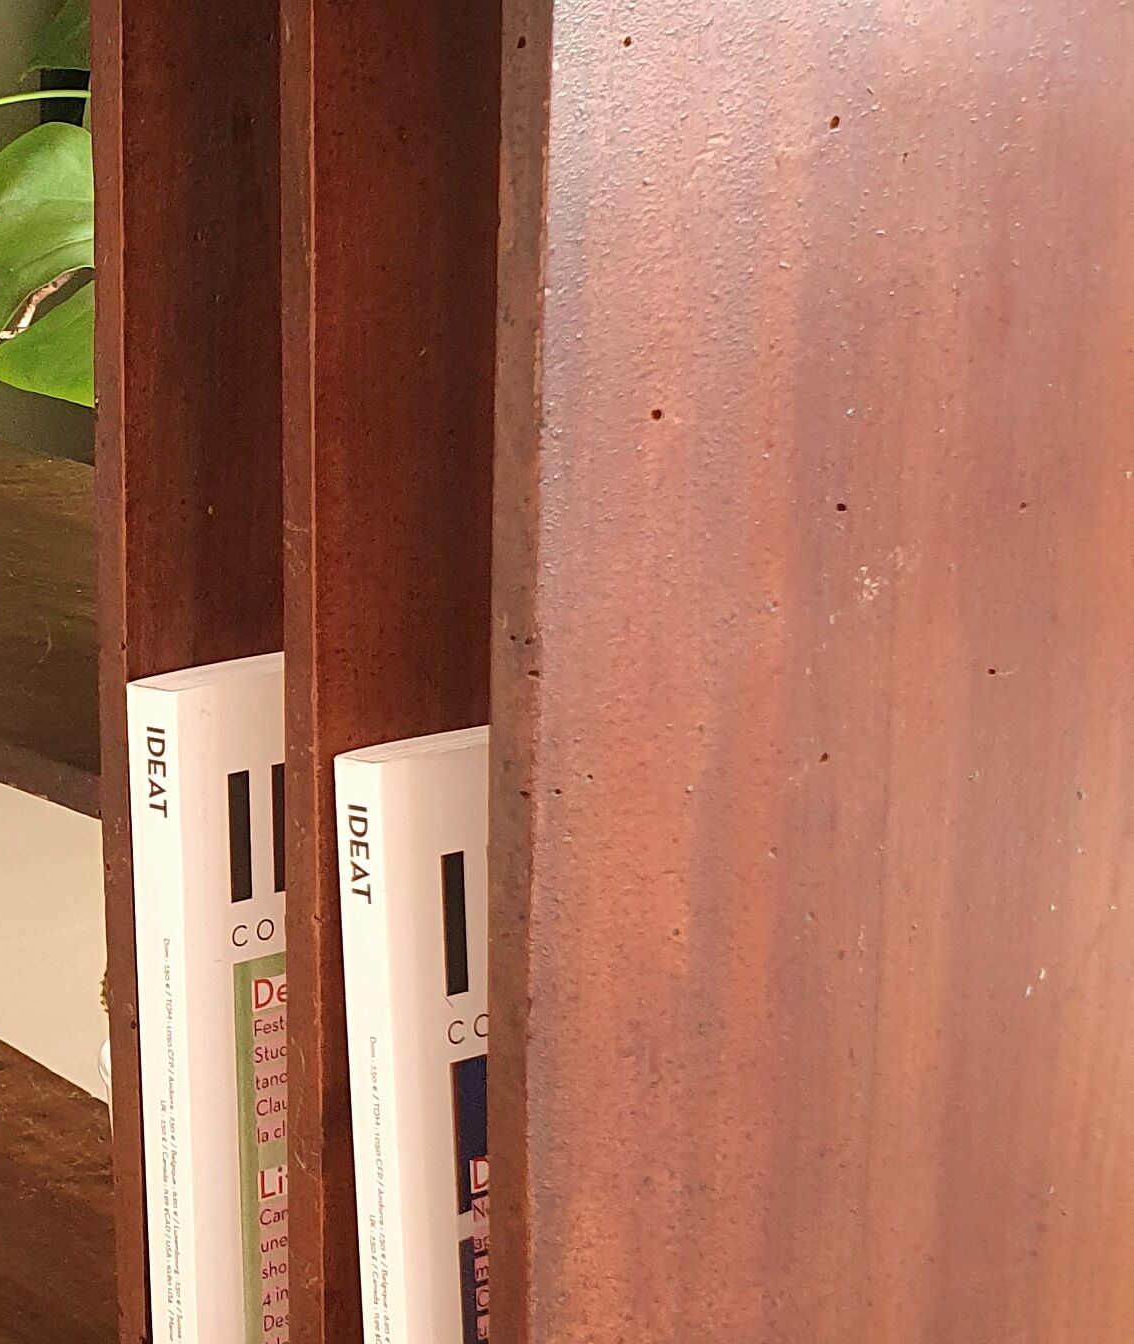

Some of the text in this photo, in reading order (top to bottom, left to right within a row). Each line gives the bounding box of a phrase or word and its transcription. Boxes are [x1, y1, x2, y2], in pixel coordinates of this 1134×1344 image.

[147, 726, 167, 818] IDEAT
[348, 804, 372, 904] IDEAT
[257, 1128, 269, 1144] la
[260, 1167, 283, 1199] Li
[261, 1235, 288, 1253] une
[262, 1261, 287, 1280] sho
